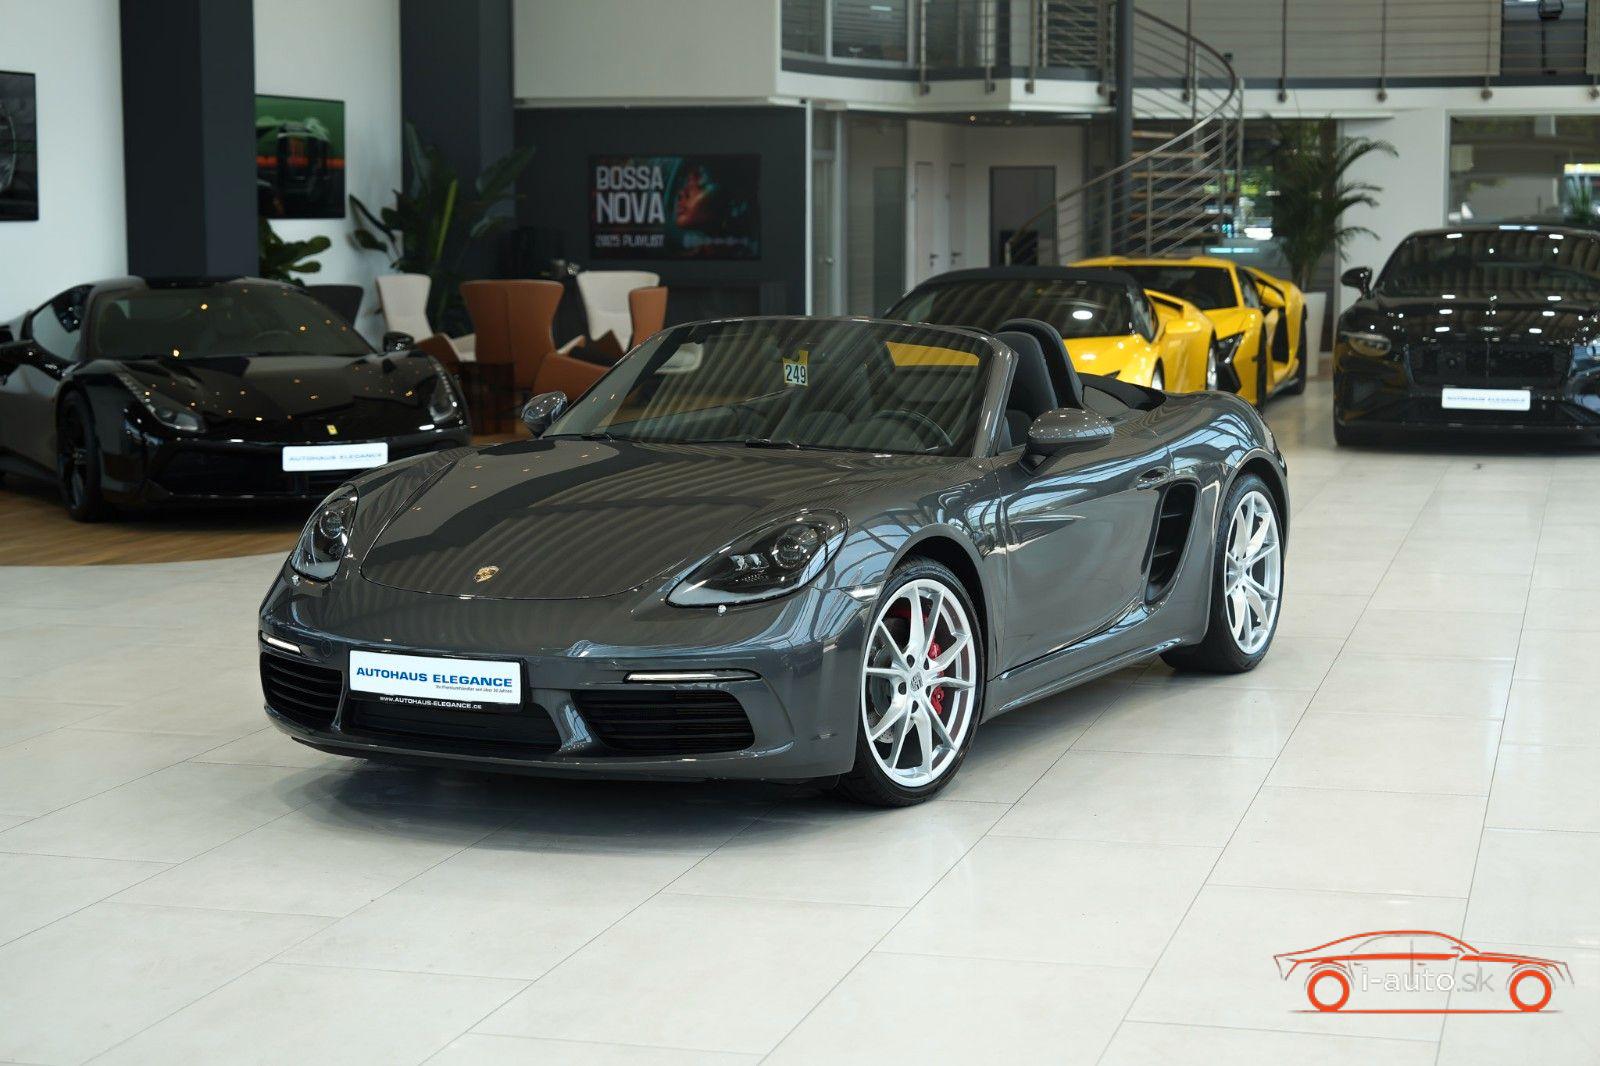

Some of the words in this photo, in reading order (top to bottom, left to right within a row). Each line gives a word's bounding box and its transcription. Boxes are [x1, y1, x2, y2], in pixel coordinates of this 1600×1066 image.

[596, 166, 664, 190] BOSSA
[596, 192, 665, 224] NOVA
[622, 234, 664, 247] PLAYLIST
[785, 364, 806, 384] 249
[356, 667, 428, 682] AUTOHAUS
[433, 674, 513, 688] ELEGANCE
